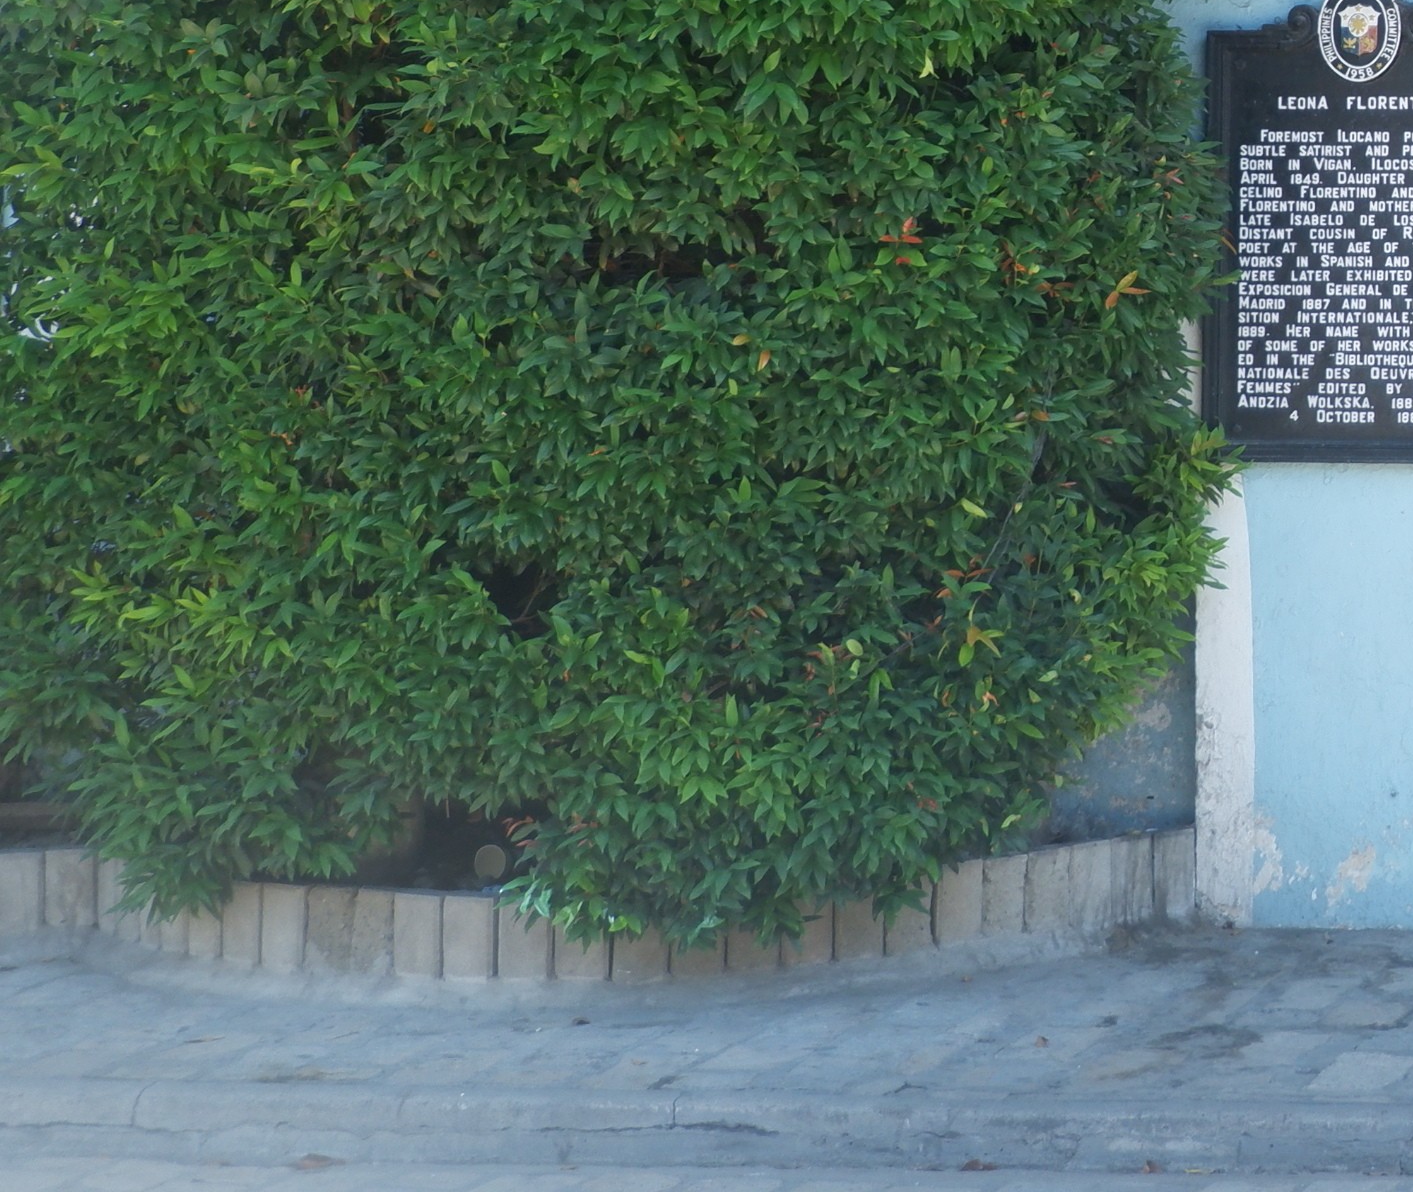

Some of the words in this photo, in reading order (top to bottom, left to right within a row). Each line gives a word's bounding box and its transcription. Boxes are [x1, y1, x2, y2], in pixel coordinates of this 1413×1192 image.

[1321, 7, 1338, 63] PHILIPPINES
[1380, 7, 1398, 61] COMMITTEE
[1345, 66, 1374, 79] 1958
[1277, 95, 1329, 110] LEONA
[1260, 128, 1325, 143] FOREMOST
[1337, 128, 1390, 143] ILOCANO
[1239, 144, 1287, 157] SUBTLE
[1298, 144, 1353, 157] SATIRIST
[1364, 144, 1390, 157] AND
[1239, 157, 1273, 171] BORN
[1287, 158, 1301, 171] IN
[1240, 170, 1278, 185] APRIL
[1290, 172, 1323, 185] 1849.
[1337, 171, 1406, 185] DAUGHTER
[1239, 186, 1283, 199] CELINO
[1300, 184, 1377, 199] FLORENTINO
[1239, 198, 1316, 213] FLORENTINO
[1329, 200, 1355, 213] AND
[1239, 214, 1272, 226] LATE
[1289, 212, 1344, 227] ISABELO
[1359, 214, 1376, 227] DE
[1239, 226, 1294, 240] DISTANT
[1309, 227, 1356, 240] COUSIN
[1371, 227, 1388, 240] OF
[1238, 241, 1271, 254] POET
[1281, 241, 1298, 254] AT
[1310, 241, 1335, 254] THE
[1346, 241, 1371, 254] AGE
[1383, 241, 1400, 254] OF
[1238, 255, 1283, 268] WORKS
[1296, 255, 1309, 268] IN
[1320, 254, 1373, 268] SPANISH
[1384, 255, 1410, 268] AND
[1240, 269, 1276, 282] WERE
[1290, 269, 1331, 282] LATER
[1346, 269, 1413, 282] EXHIBITED
[1325, 282, 1383, 297] GENERAL
[1392, 283, 1409, 297] DE
[1238, 295, 1286, 310] MADRID
[1302, 298, 1331, 311] 1887
[1341, 297, 1367, 311] AND
[1379, 298, 1392, 311] IN
[1238, 311, 1280, 324] SITION
[1238, 325, 1270, 338] 1889.
[1285, 323, 1311, 338] HER
[1325, 325, 1360, 338] NAME
[1376, 325, 1411, 338] WITH
[1237, 339, 1253, 352] OF
[1264, 339, 1298, 352] SOME
[1309, 340, 1326, 352] OF
[1337, 339, 1361, 352] HER
[1237, 353, 1254, 366] ED
[1266, 353, 1279, 366] IN
[1291, 353, 1316, 366] THE
[1237, 367, 1310, 380] NATIONALE
[1325, 367, 1351, 380] DES
[1317, 382, 1366, 396] EDITED
[1385, 382, 1403, 395] BY
[1237, 393, 1289, 408] ANDZIA
[1289, 409, 1299, 422] 4
[1316, 409, 1376, 424] OCTOBER
